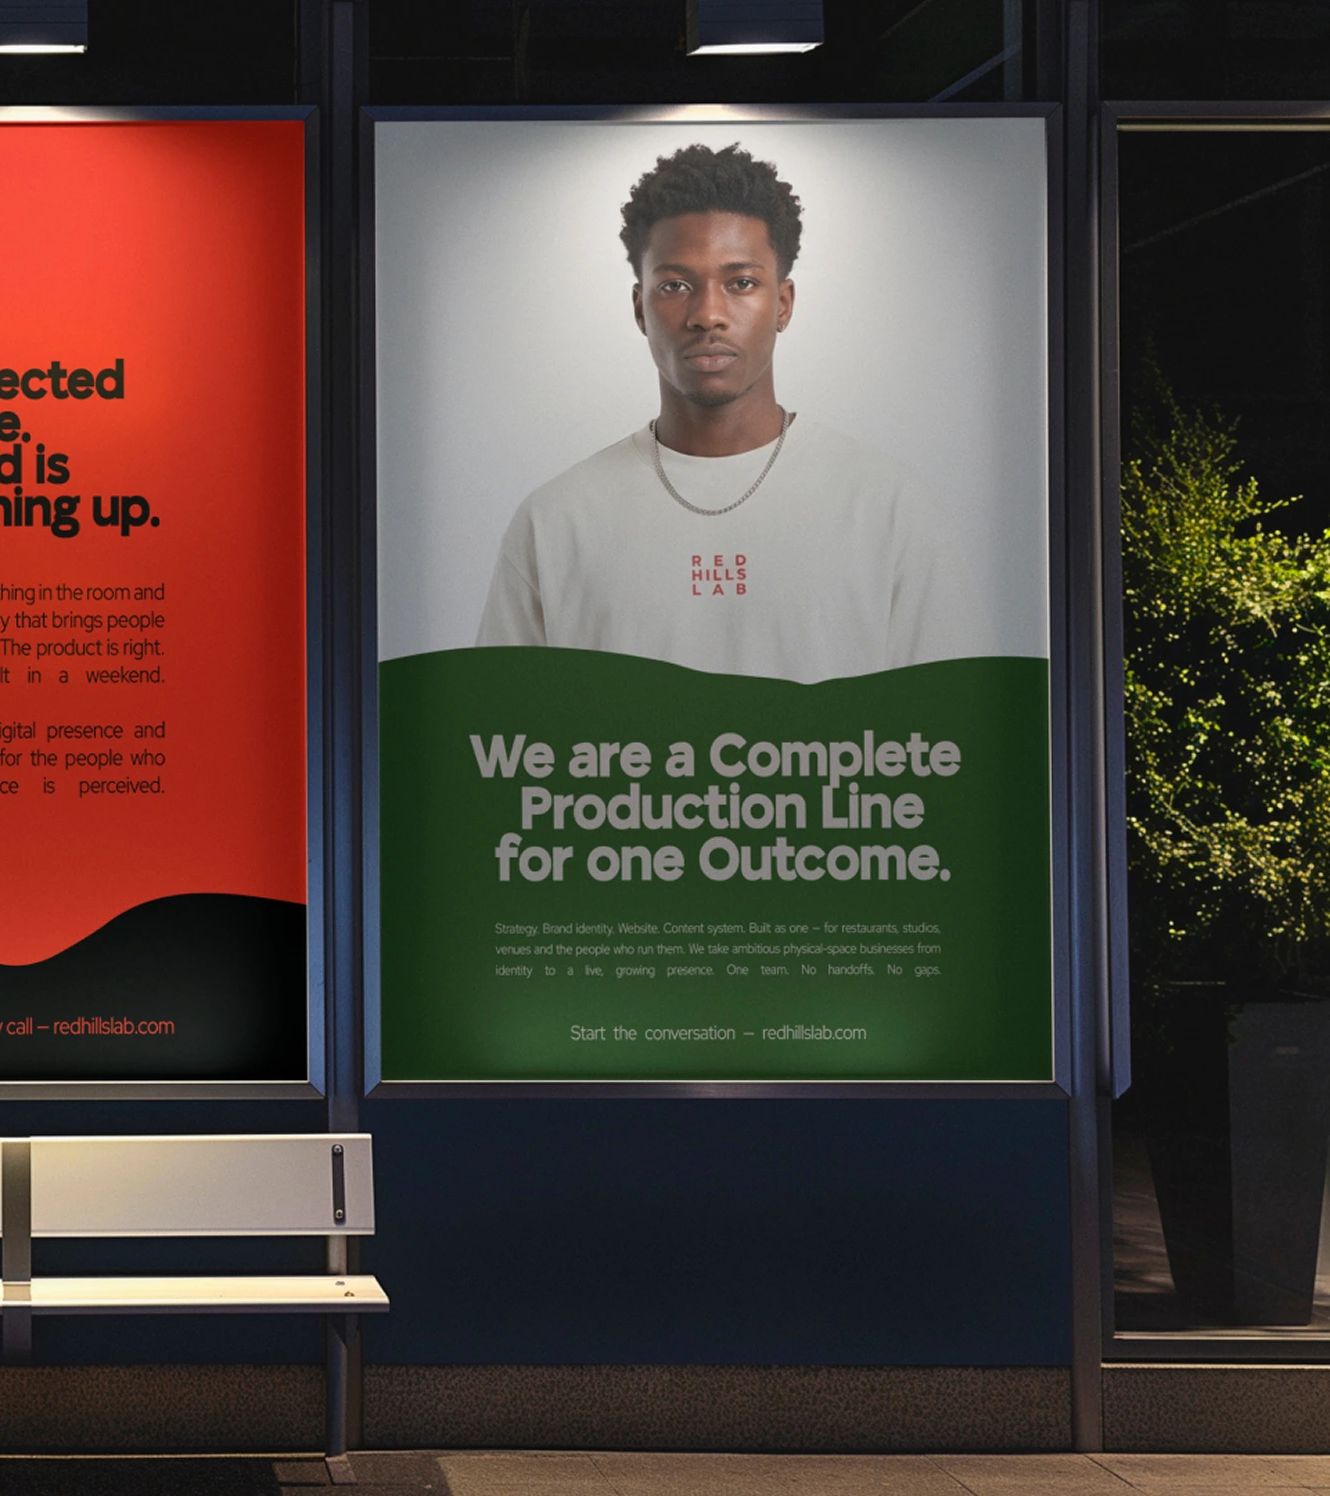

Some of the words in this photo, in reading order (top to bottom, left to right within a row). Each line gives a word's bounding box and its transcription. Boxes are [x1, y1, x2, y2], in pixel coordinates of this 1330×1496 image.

[35, 442, 71, 485] is
[91, 494, 161, 538] up.
[691, 554, 747, 567] RED
[691, 567, 747, 582] HILLS
[692, 582, 747, 596] LAB
[14, 610, 48, 629] that
[51, 610, 104, 633] brings
[107, 610, 166, 633] people
[0, 637, 32, 657] The
[36, 638, 103, 660] product
[106, 638, 120, 657] is
[122, 638, 165, 661] right.
[27, 666, 42, 684] in
[58, 669, 69, 684] a
[85, 665, 165, 684] weekend.
[46, 724, 124, 743] presence
[133, 720, 166, 739] and
[469, 733, 556, 779] We
[568, 741, 652, 779] are
[664, 741, 695, 778] a
[709, 729, 963, 788] Complete
[43, 776, 56, 795] is
[79, 775, 165, 799] perceived.
[521, 781, 807, 831] Production
[822, 781, 926, 830] Line
[494, 832, 574, 882] for
[586, 845, 685, 882] one
[698, 836, 951, 882] Outcome.
[494, 922, 539, 938] Strategy.
[542, 922, 573, 935] Brand
[575, 922, 614, 937] identity.
[617, 922, 659, 935] Website.
[662, 921, 705, 934] Content
[706, 923, 746, 937] system.
[748, 921, 772, 934] Built
[774, 924, 787, 934] as
[788, 924, 809, 934] one
[823, 921, 839, 934] for
[841, 922, 899, 935] restaurants,
[902, 921, 941, 934] studios,
[5, 1016, 33, 1036] call
[53, 1016, 175, 1035] redhillslab.com
[570, 1024, 607, 1041] Start
[612, 1025, 638, 1041] the
[644, 1024, 736, 1041] conversation
[762, 1024, 867, 1041] redhillslab.com
